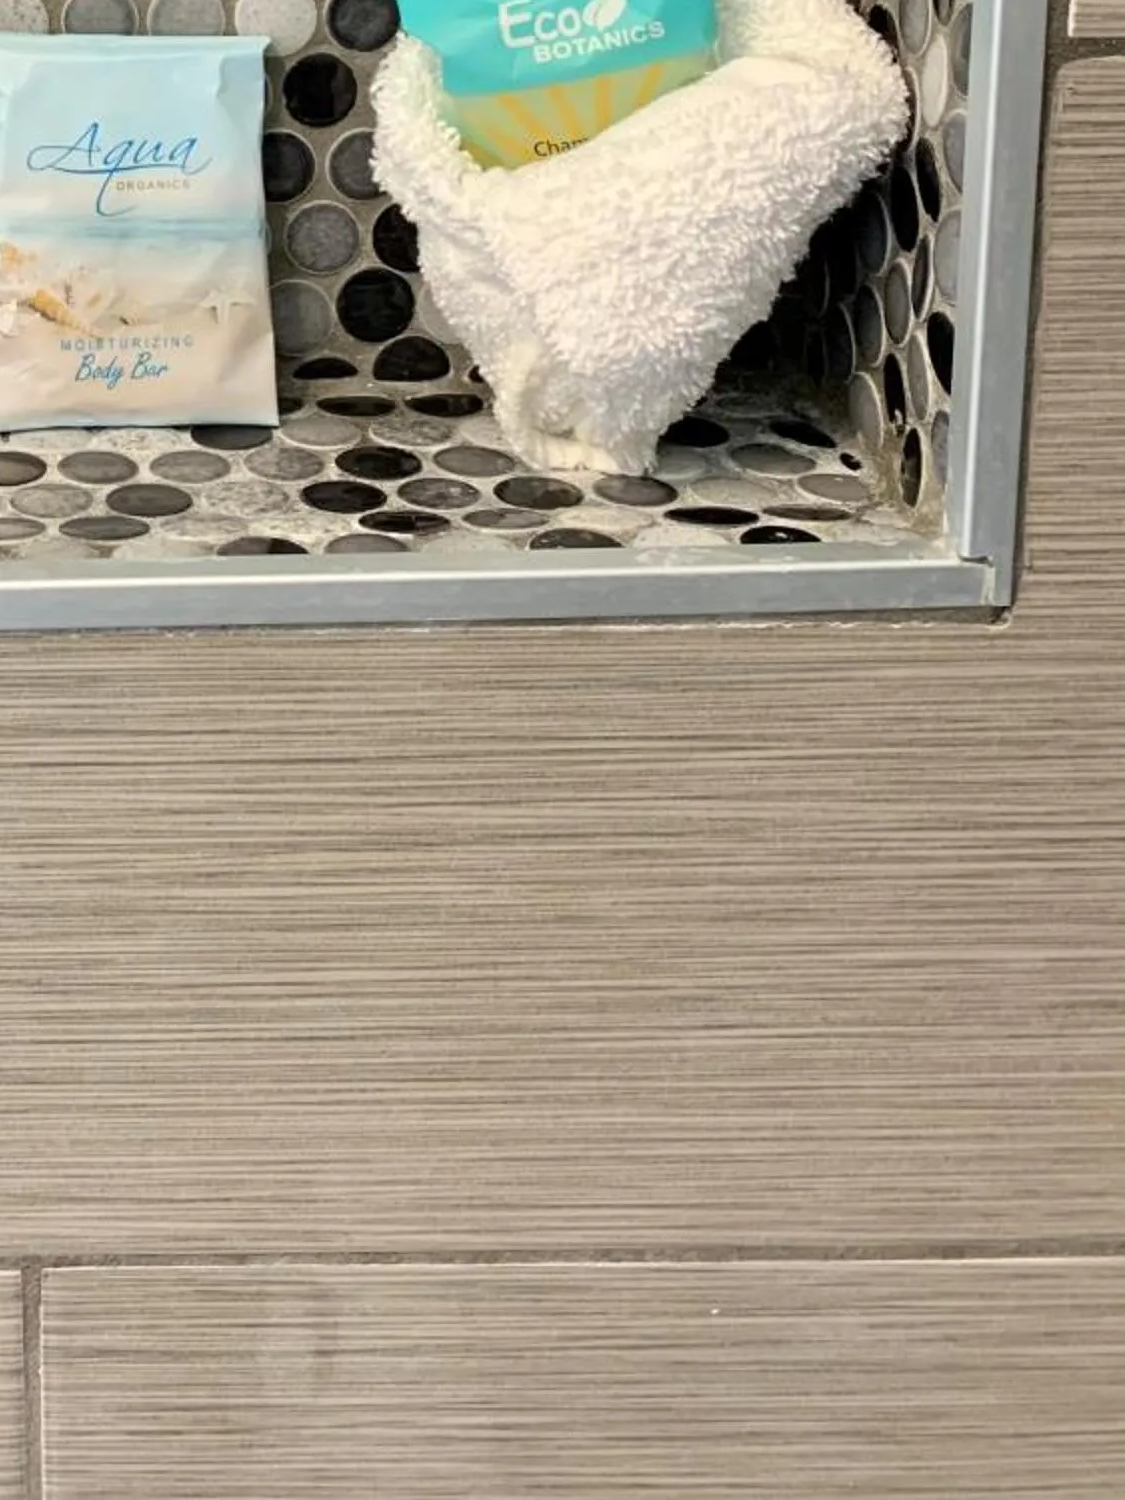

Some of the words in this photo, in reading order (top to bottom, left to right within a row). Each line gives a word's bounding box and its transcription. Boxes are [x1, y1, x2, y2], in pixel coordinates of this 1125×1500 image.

[533, 21, 665, 64] BOTANICS
[26, 120, 213, 217] Aqua
[115, 178, 192, 192] ORGANICS
[59, 334, 195, 351] MOISTURIZING
[74, 353, 124, 390] Body
[130, 351, 169, 380] Bar
